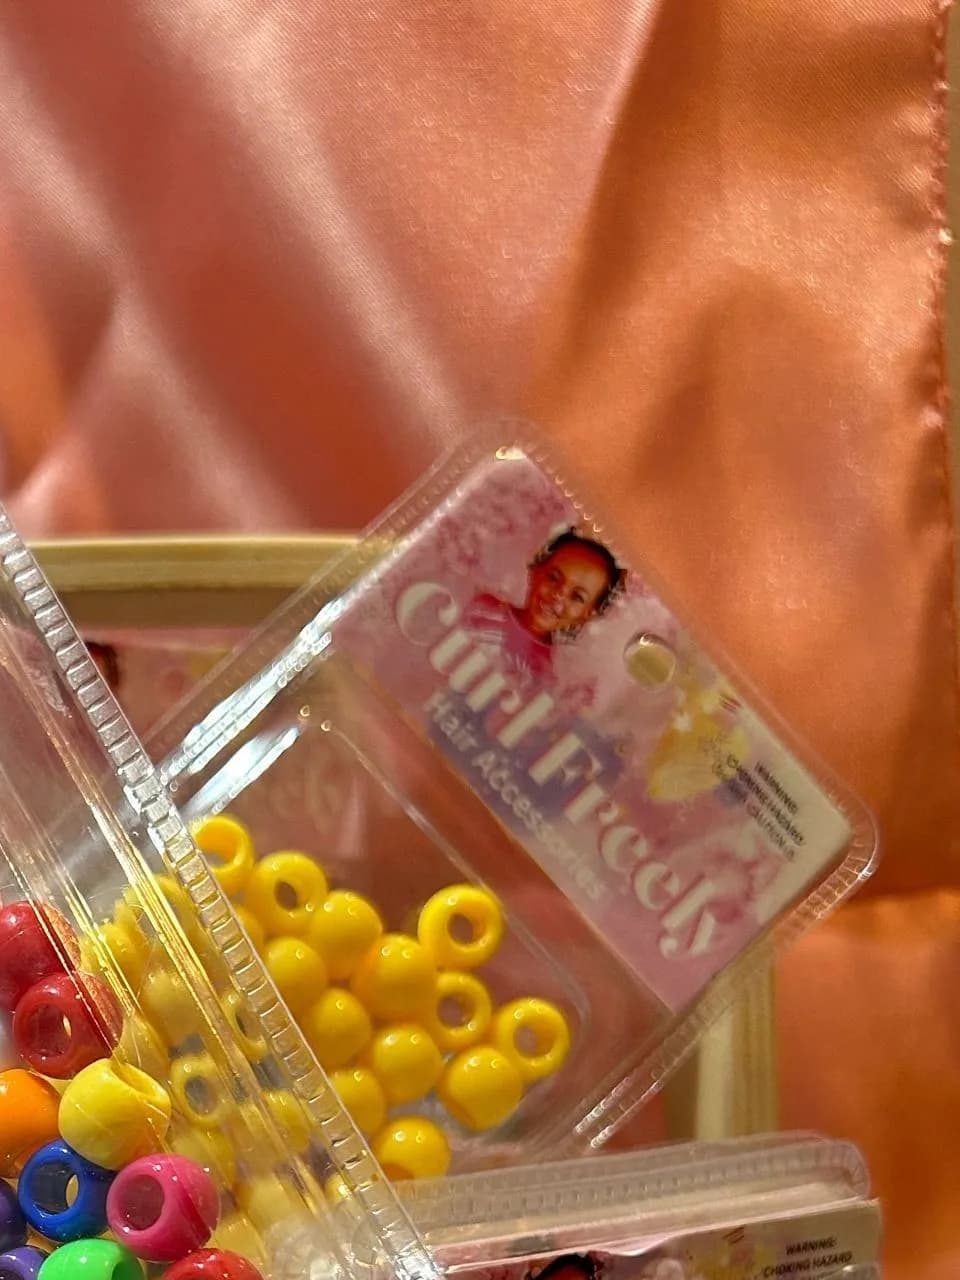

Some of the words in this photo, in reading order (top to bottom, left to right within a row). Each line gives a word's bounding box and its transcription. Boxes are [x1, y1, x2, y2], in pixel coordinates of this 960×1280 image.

[395, 581, 555, 748] Curl
[528, 733, 718, 961] Freely
[424, 691, 478, 752] Hair
